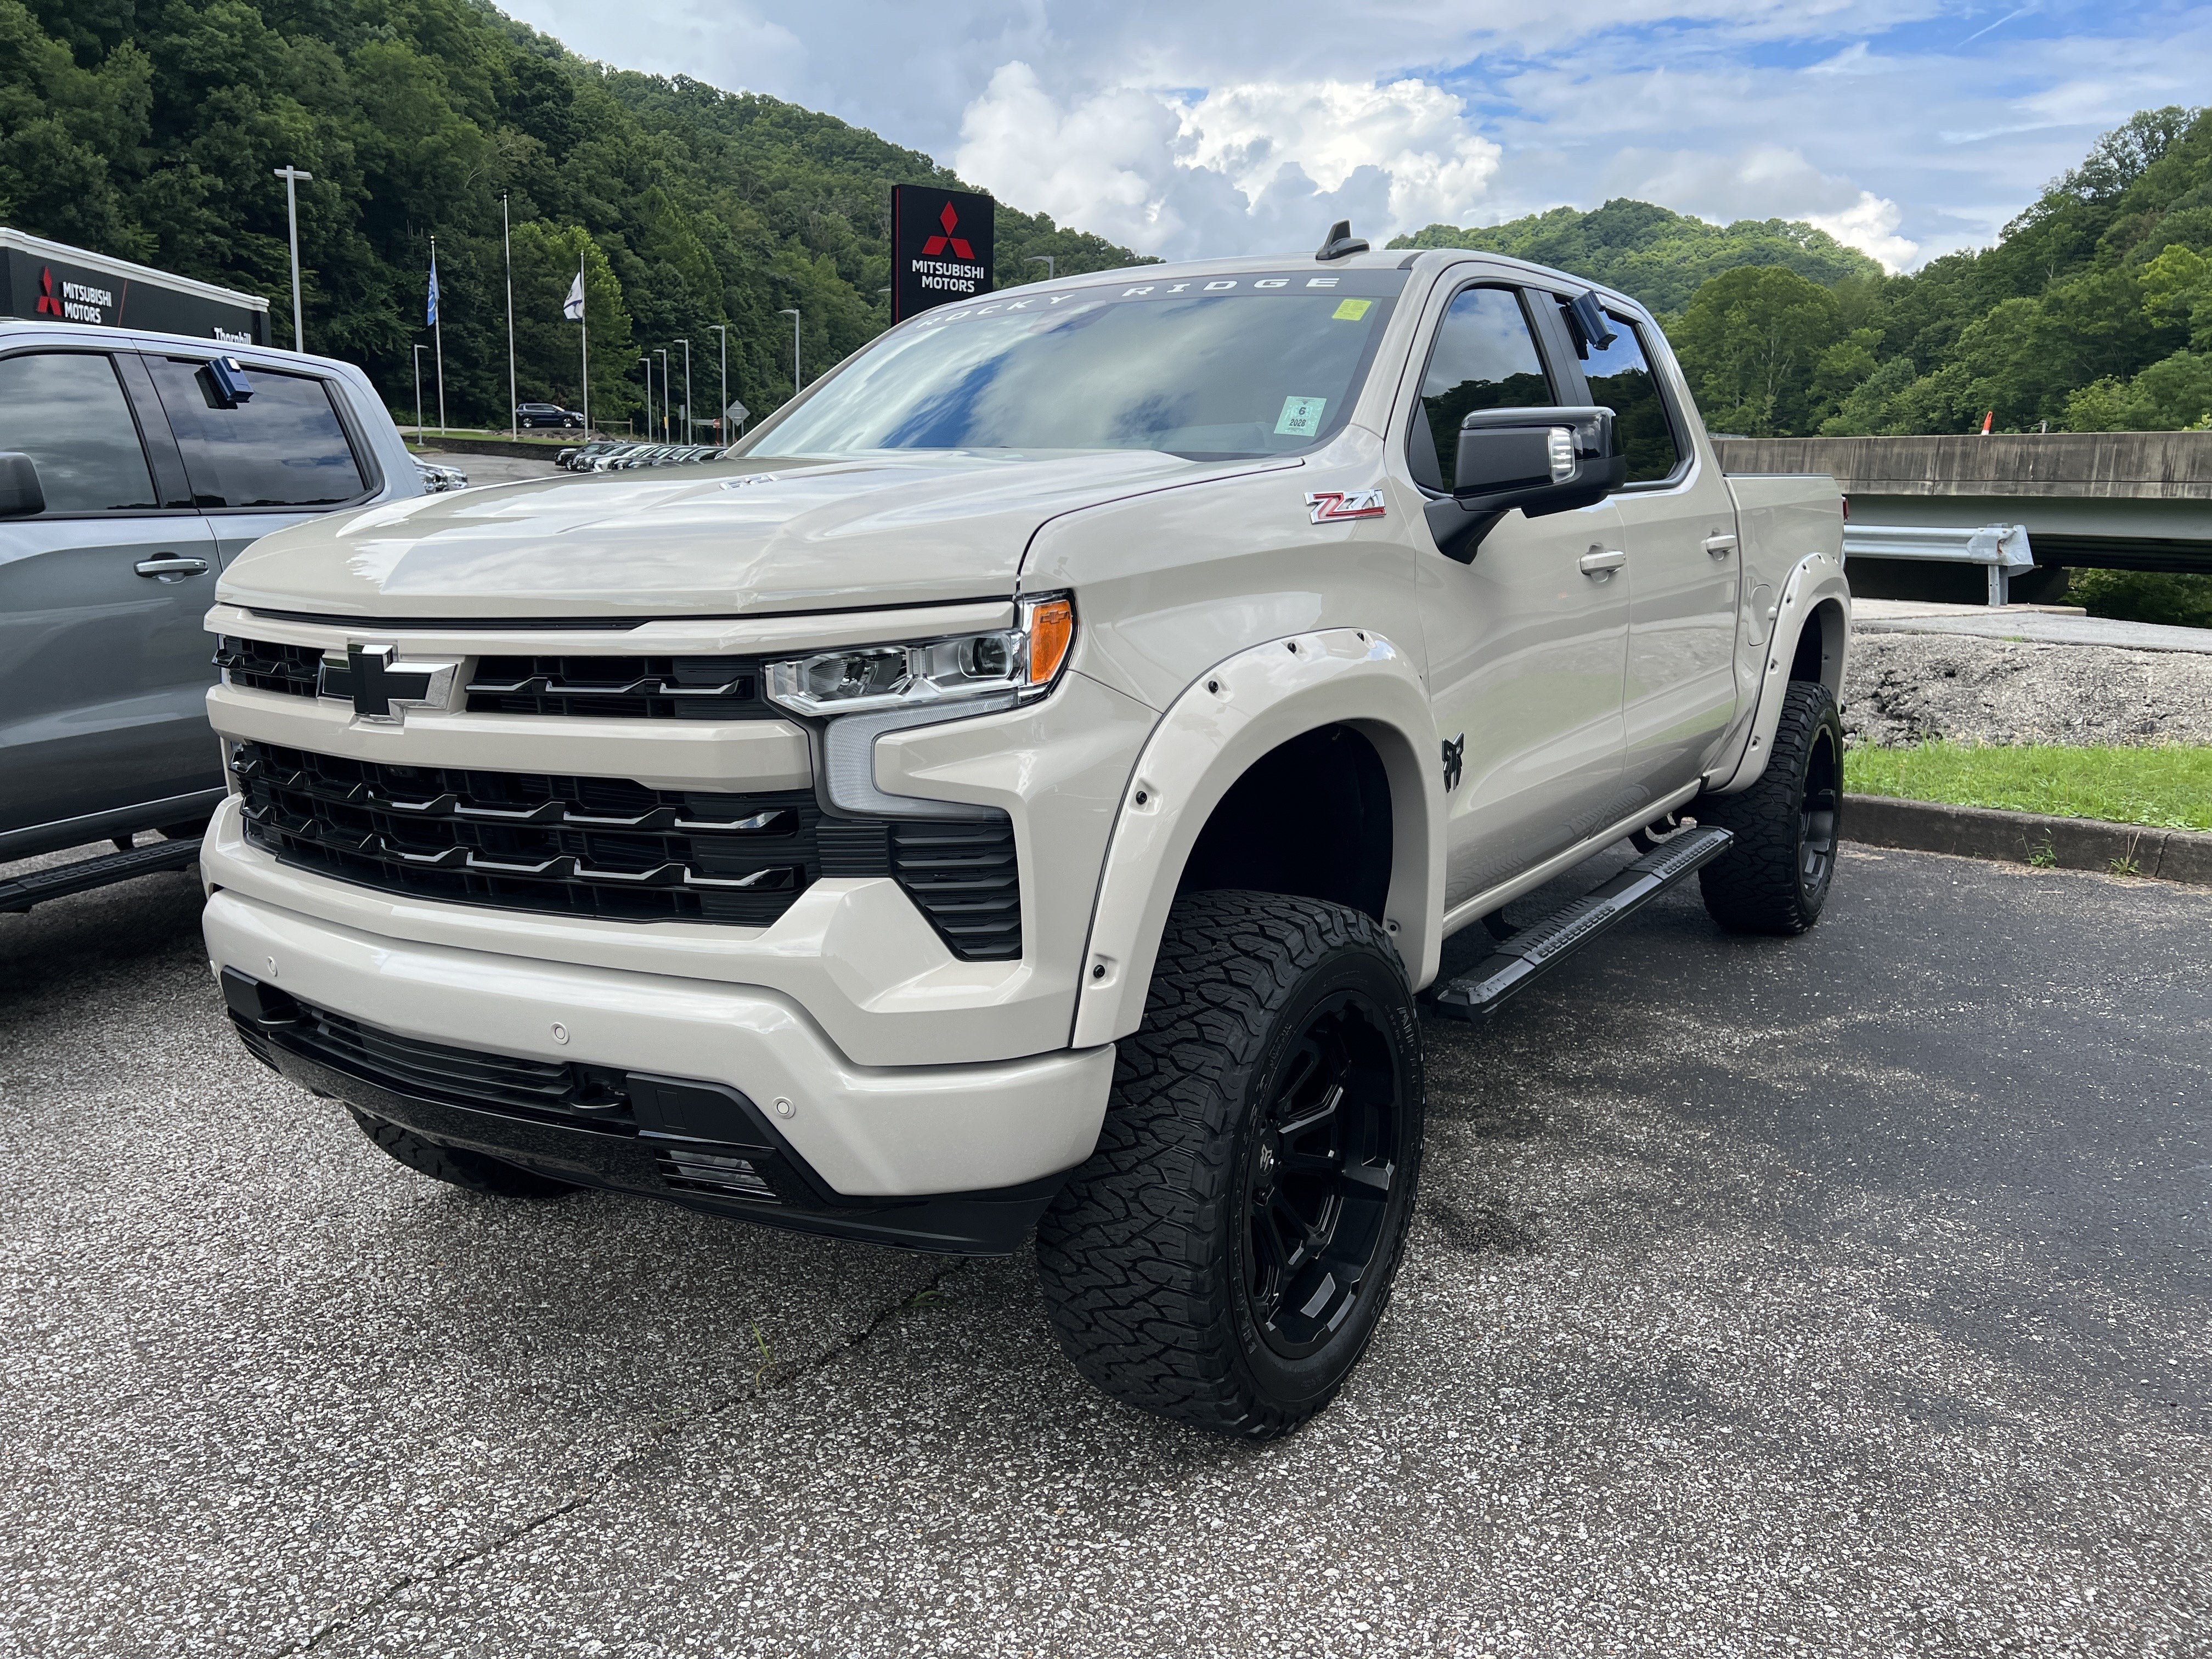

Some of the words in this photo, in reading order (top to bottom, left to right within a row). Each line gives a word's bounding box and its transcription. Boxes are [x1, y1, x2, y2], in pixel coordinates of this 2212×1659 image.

[911, 259, 985, 279] MITSUBISHI
[63, 281, 112, 307] MITSUBISHI
[921, 275, 975, 294] MOTORS
[915, 294, 1076, 329] ROCKY
[1121, 277, 1340, 297] RIDGE
[64, 304, 102, 324] MOTORS
[1298, 407, 1306, 415] 6
[1289, 419, 1306, 427] 2028
[1304, 488, 1387, 525] Z71
